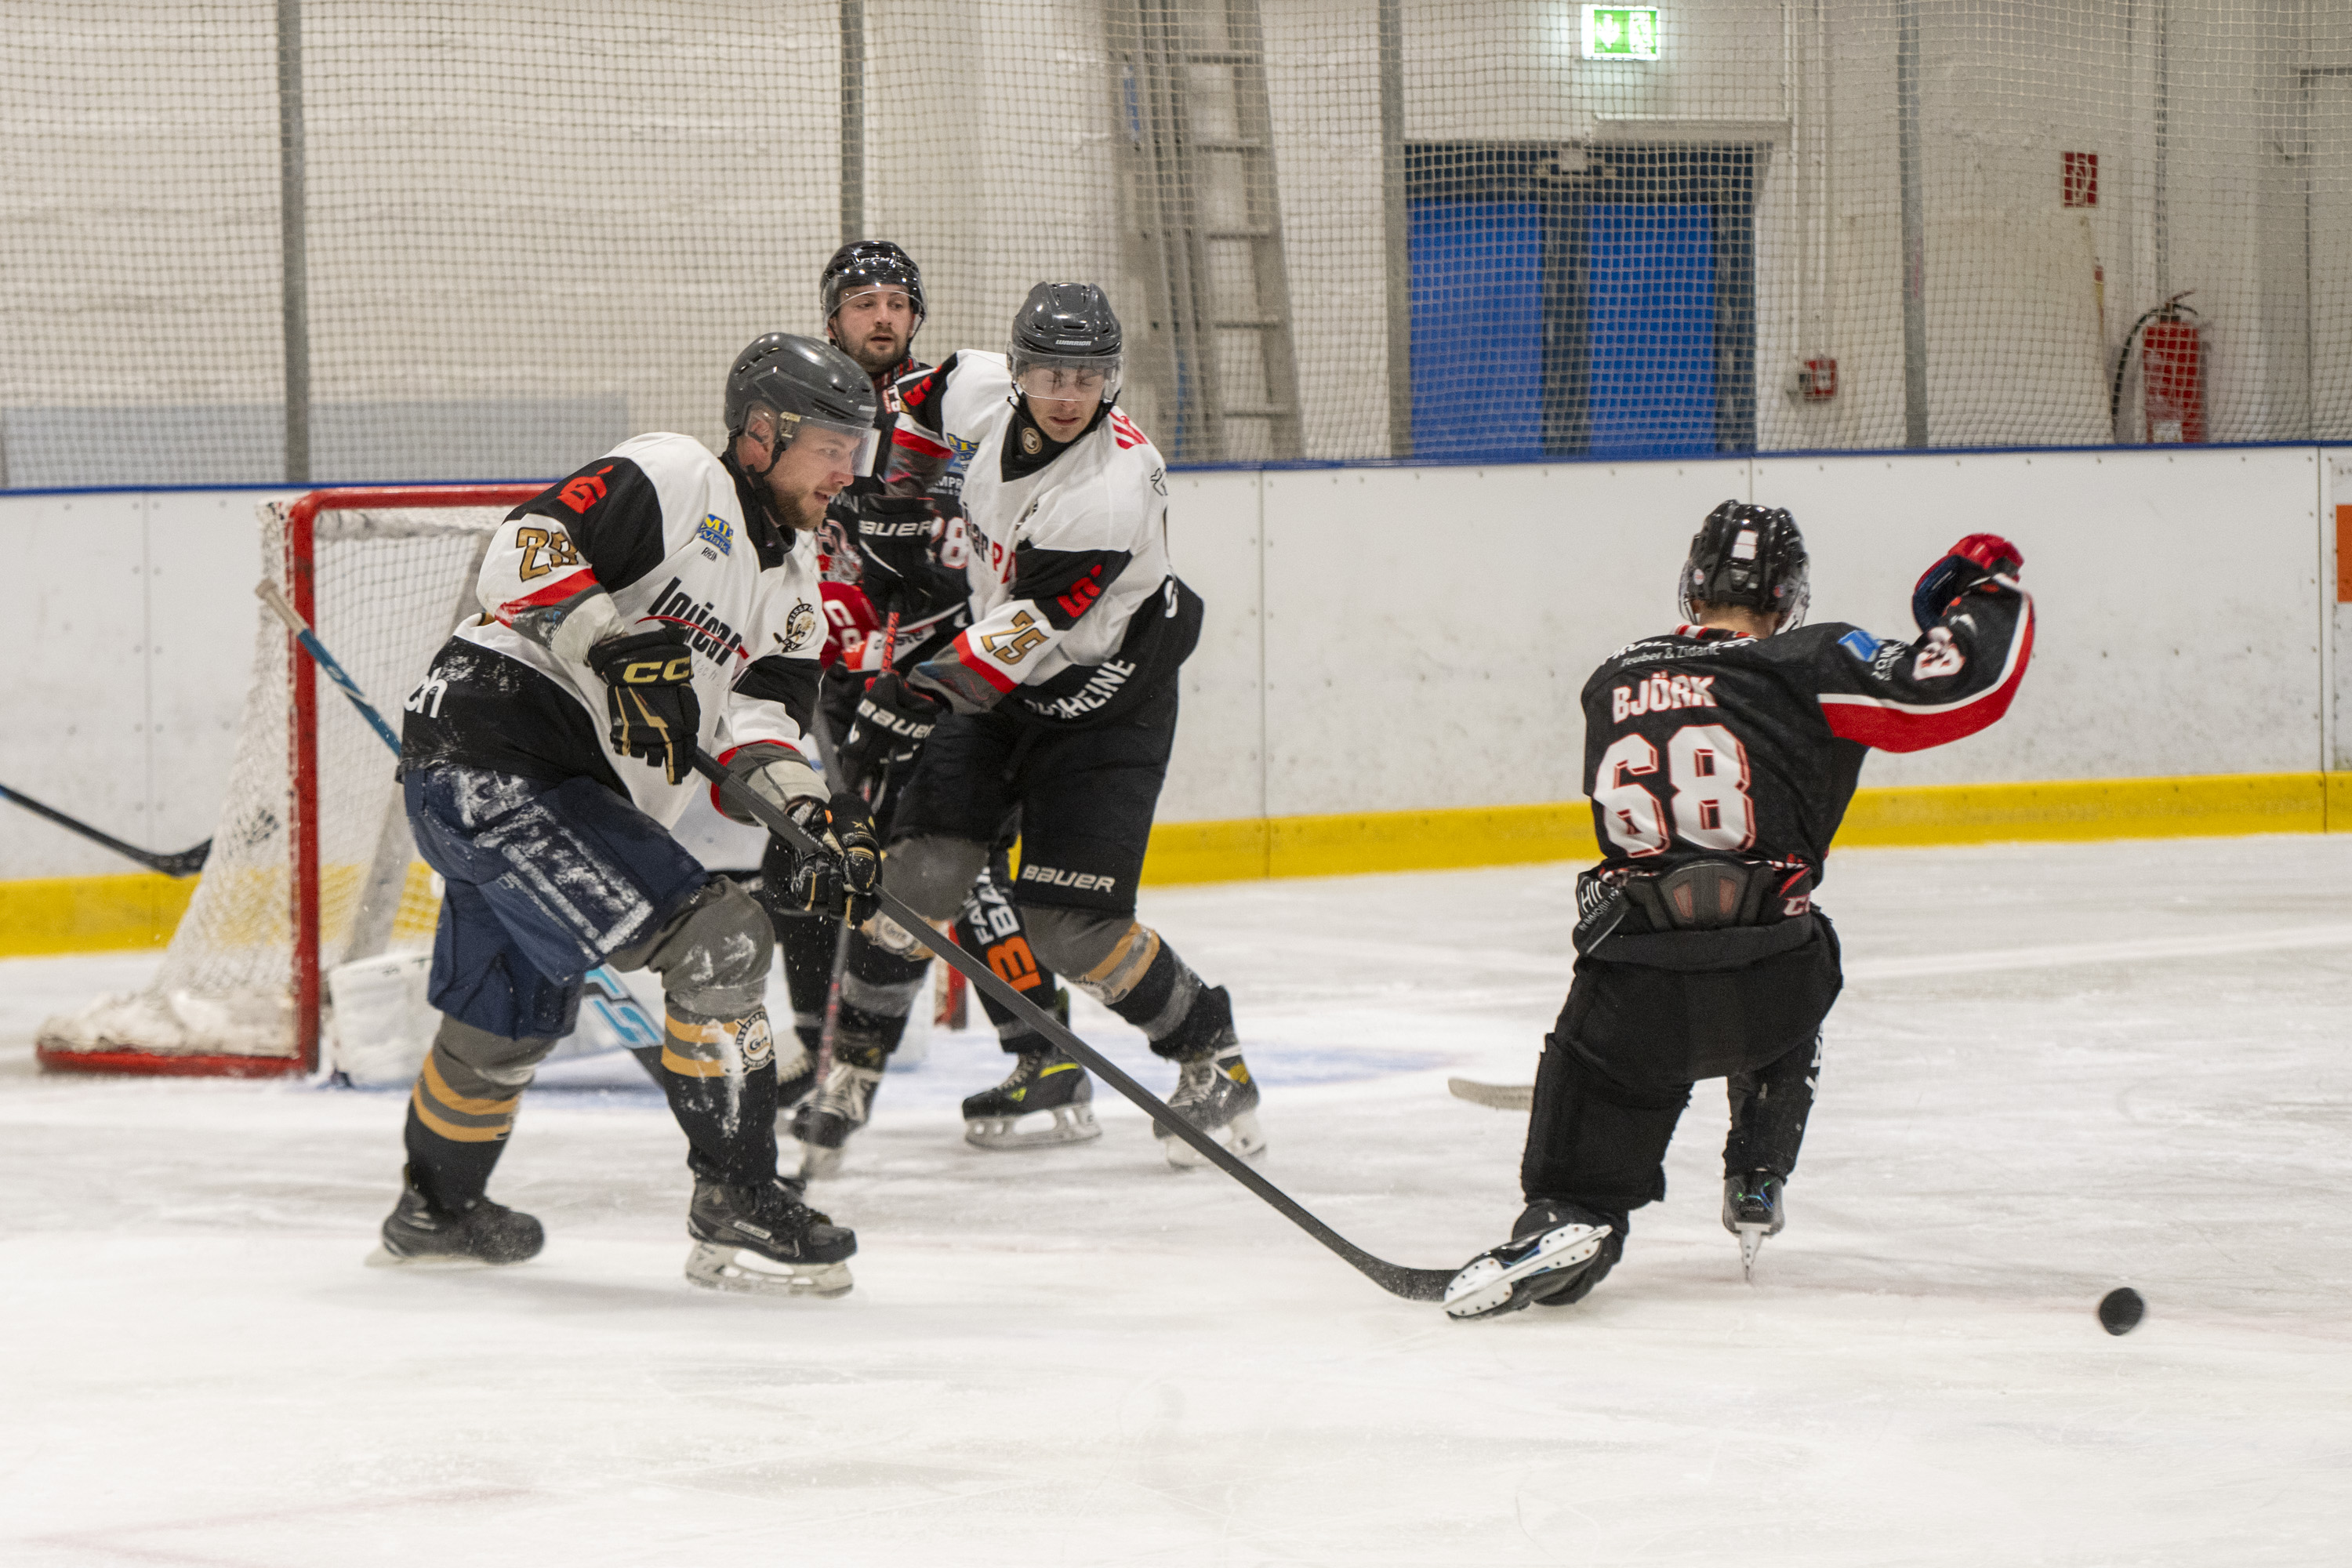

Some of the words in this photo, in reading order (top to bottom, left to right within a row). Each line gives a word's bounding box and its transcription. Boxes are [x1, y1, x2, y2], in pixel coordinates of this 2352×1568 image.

[981, 610, 1050, 665] 25
[1612, 670, 1718, 724] BJÖRK
[1592, 724, 1756, 858] 68
[1022, 865, 1116, 893] BAUER
